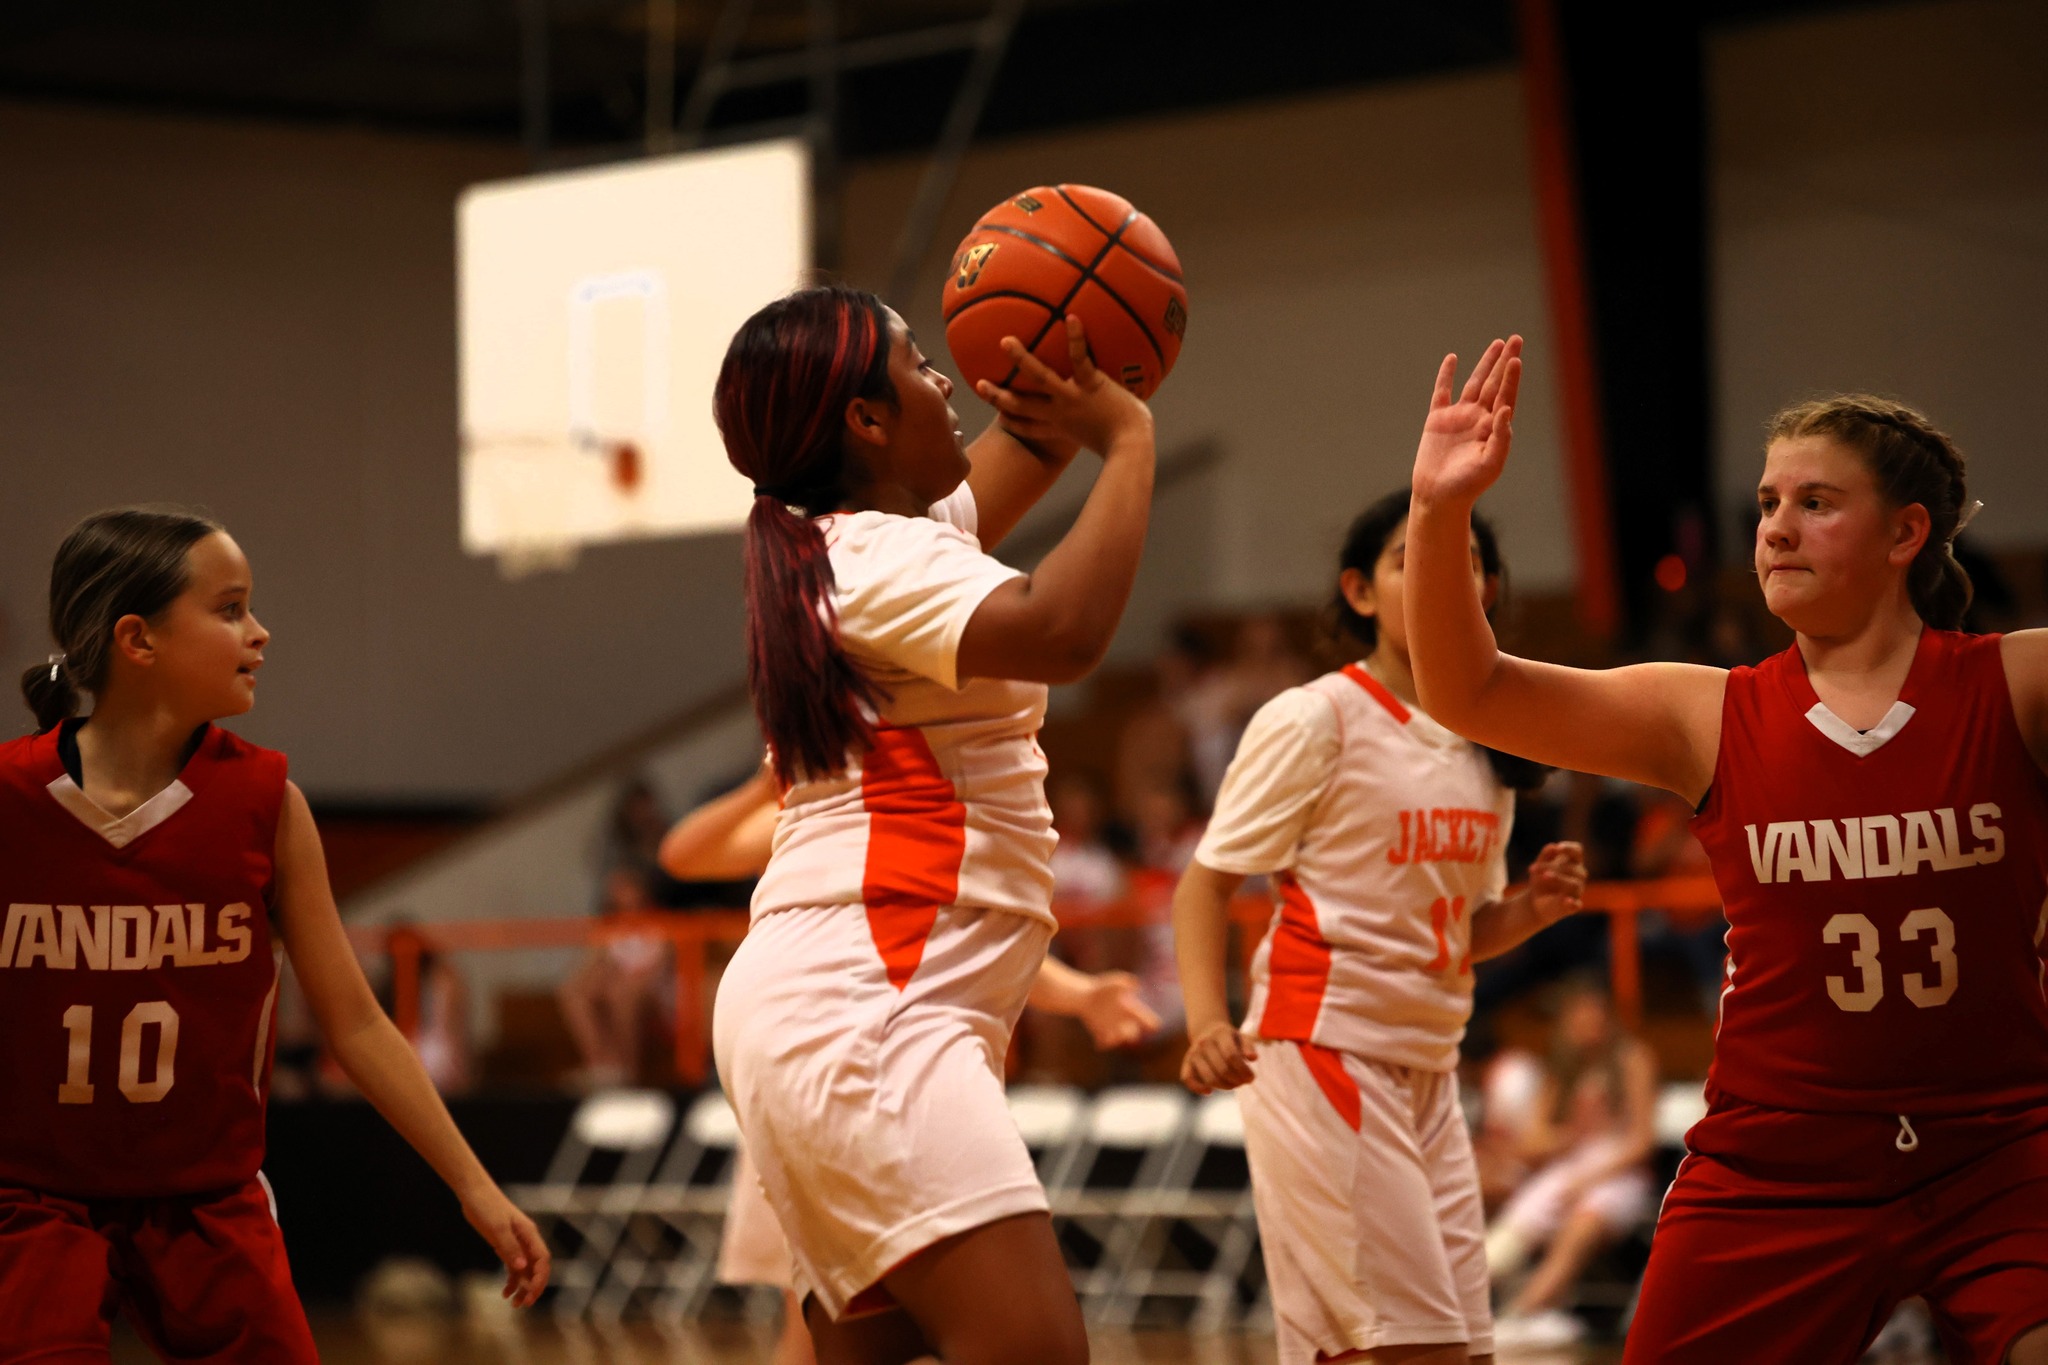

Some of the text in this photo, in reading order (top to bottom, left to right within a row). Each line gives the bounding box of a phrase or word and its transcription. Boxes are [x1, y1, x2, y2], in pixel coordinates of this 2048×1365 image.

[1744, 802, 2005, 884] VANDALS
[1822, 907, 1959, 1012] 33
[58, 1001, 180, 1104] 10
